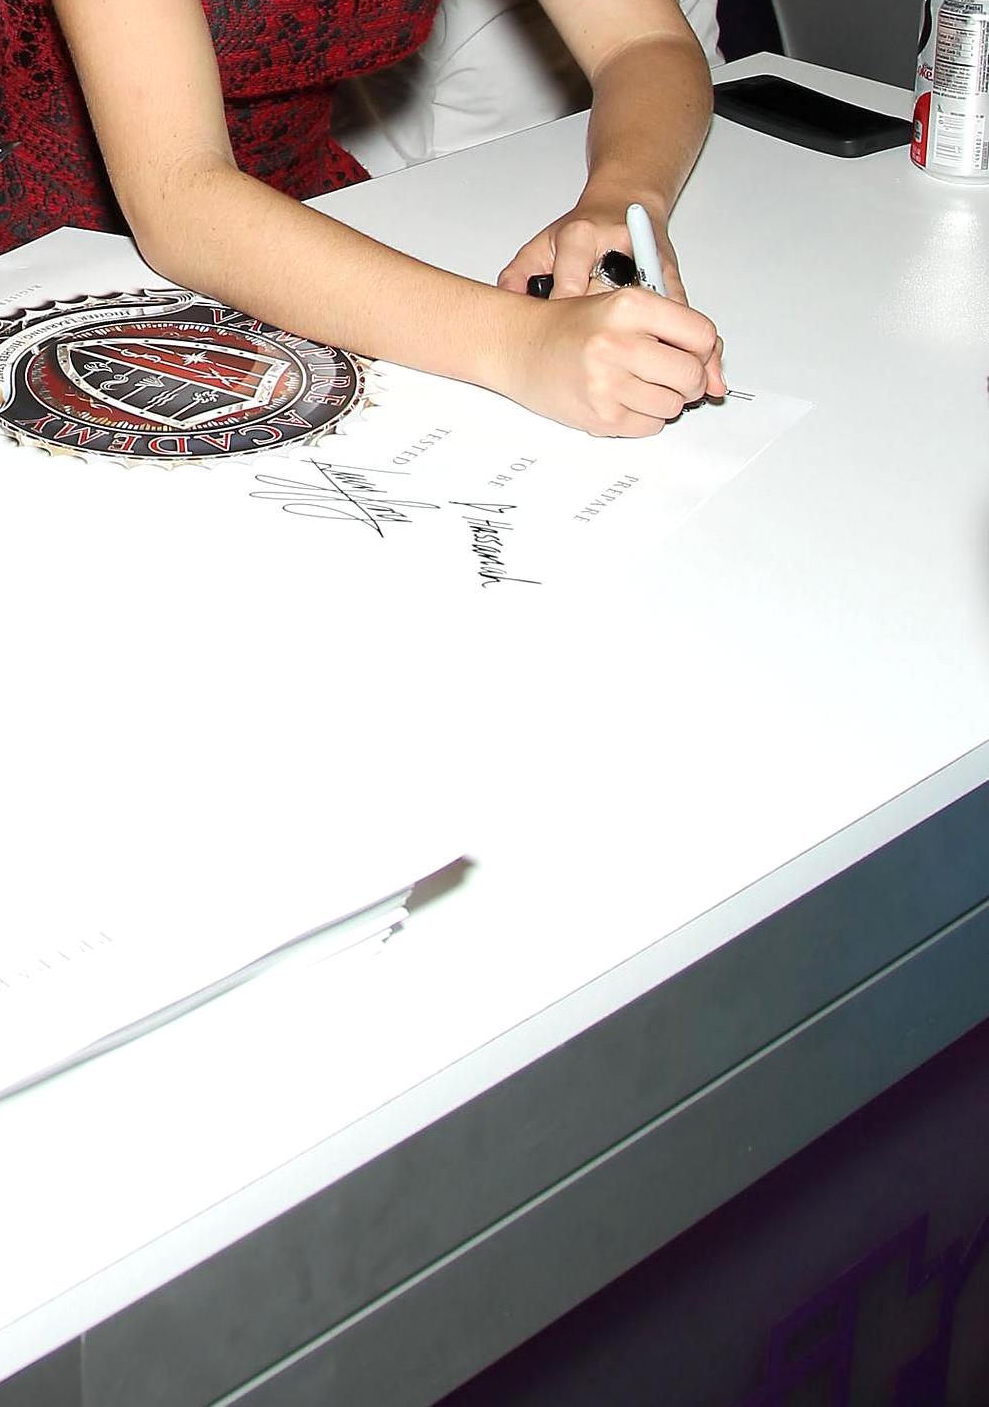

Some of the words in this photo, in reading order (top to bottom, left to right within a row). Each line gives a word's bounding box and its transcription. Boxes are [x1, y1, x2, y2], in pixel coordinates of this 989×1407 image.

[14, 409, 314, 456] ACADEMY
[391, 427, 452, 466] TESTED
[486, 474, 511, 489] BE
[510, 456, 537, 472] TO
[573, 474, 640, 524] PREPARE
